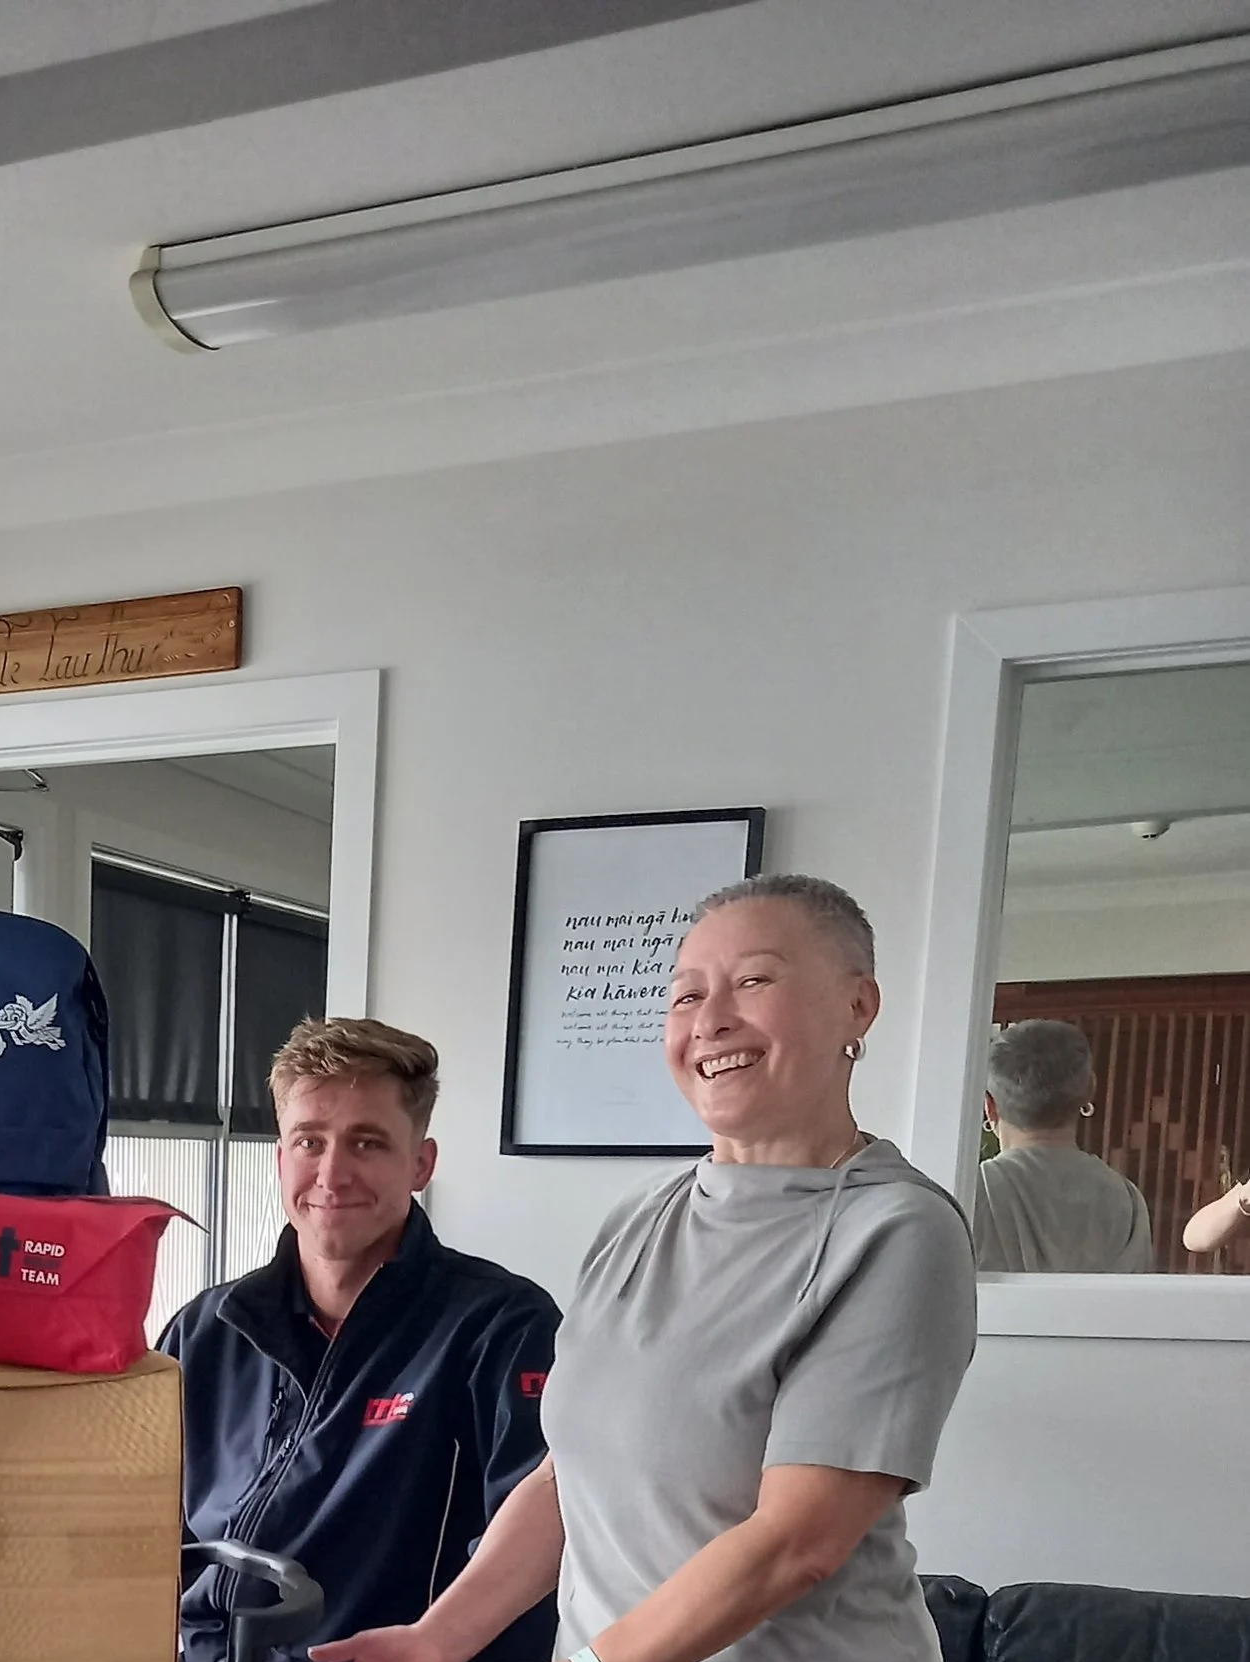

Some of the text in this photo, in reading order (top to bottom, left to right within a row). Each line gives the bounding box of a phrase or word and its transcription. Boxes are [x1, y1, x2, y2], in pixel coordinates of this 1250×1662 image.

[565, 916, 601, 930] nau
[606, 911, 633, 928] mai
[563, 939, 596, 952] nau
[603, 935, 634, 951] mai
[561, 963, 590, 976] nau
[597, 961, 626, 977] mai
[631, 958, 663, 976] kia
[565, 985, 597, 1002] kia
[24, 1240, 65, 1258] RAPID
[20, 1268, 60, 1286] TEAM
